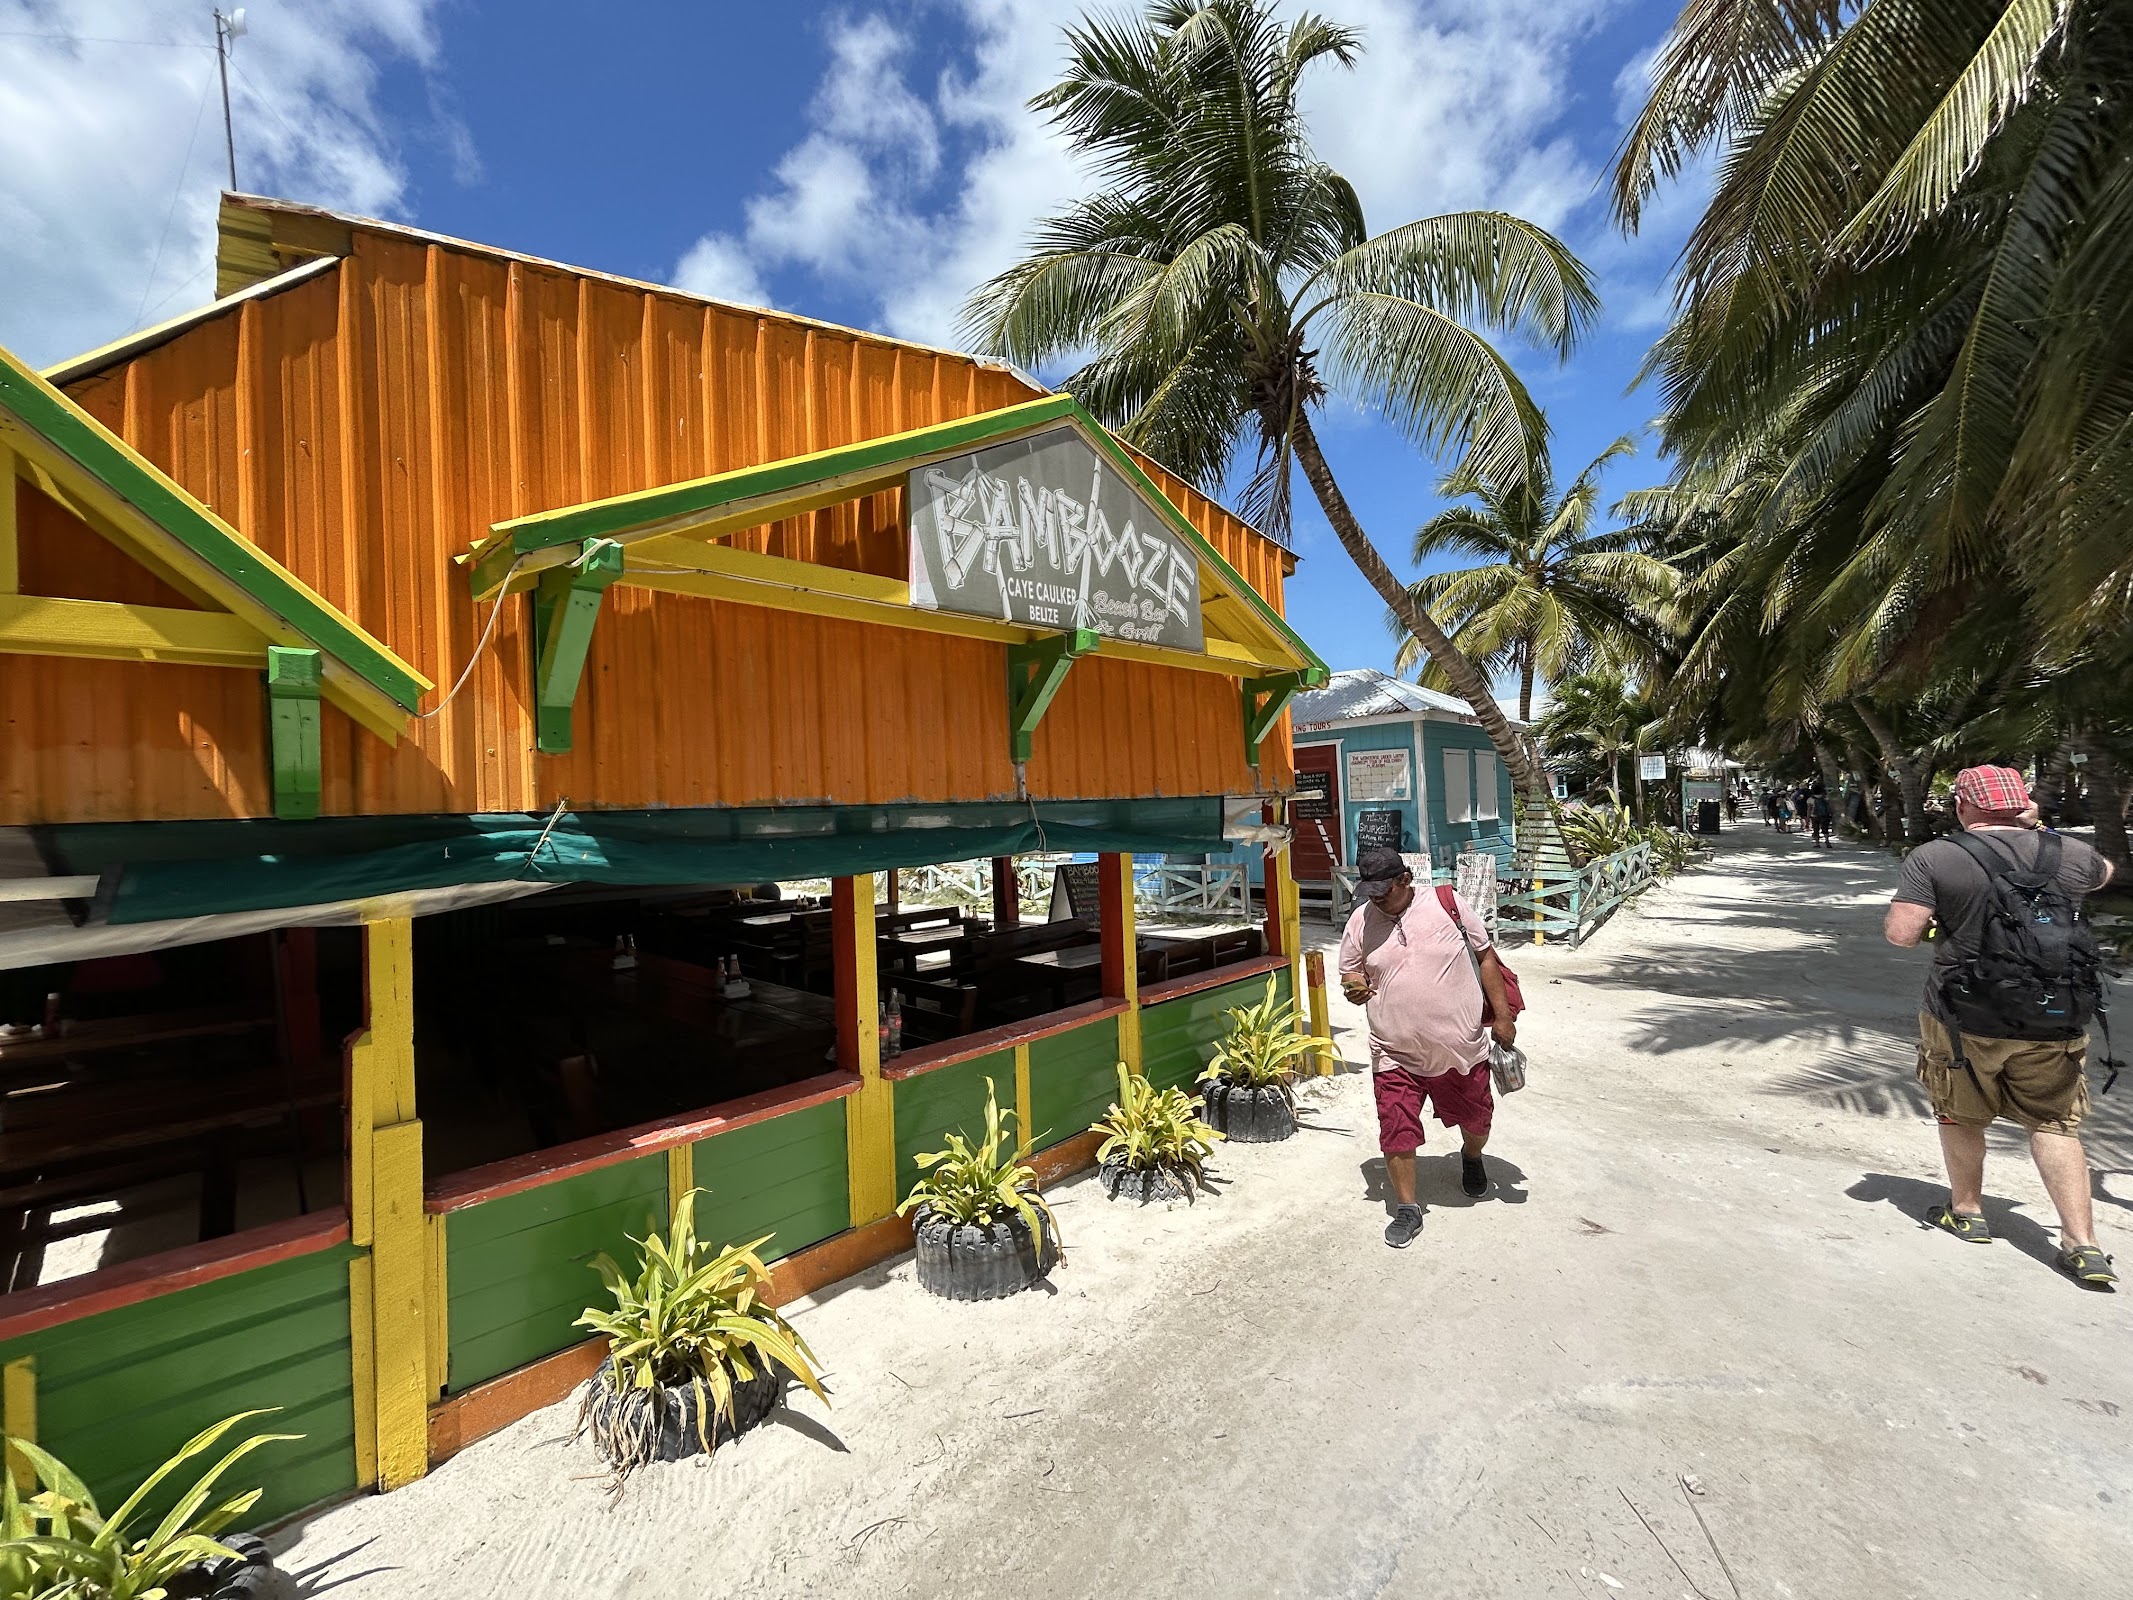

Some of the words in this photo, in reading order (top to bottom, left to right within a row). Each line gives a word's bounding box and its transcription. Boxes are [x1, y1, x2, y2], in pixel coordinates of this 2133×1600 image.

[924, 468, 1195, 627] BAMBOOZE
[1007, 577, 1034, 599] CAYE
[1036, 582, 1077, 606] CAULKER
[1029, 604, 1059, 624] BELIZE
[1092, 590, 1139, 619] Beach
[1140, 598, 1169, 624] Bar
[1092, 619, 1115, 637] &
[1119, 621, 1164, 642] Grill
[1292, 724, 1307, 733] LING
[1309, 721, 1331, 731] TOURS
[1477, 855, 1489, 863] DAY
[1067, 866, 1099, 876] BAMBOO
